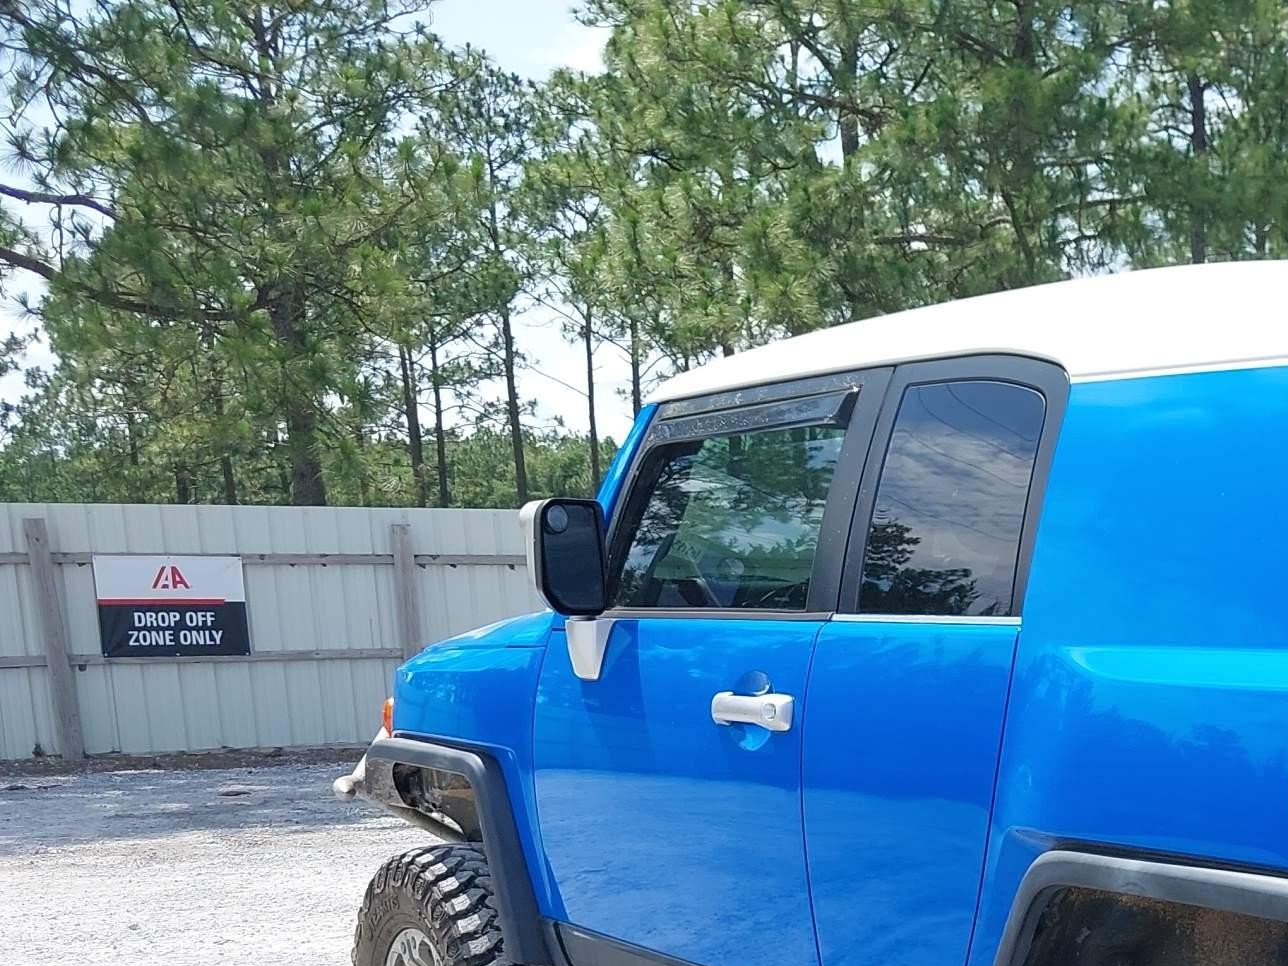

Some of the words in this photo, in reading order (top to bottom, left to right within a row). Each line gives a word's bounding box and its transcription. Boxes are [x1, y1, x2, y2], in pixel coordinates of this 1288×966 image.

[133, 612, 180, 628] DROP
[185, 612, 216, 627] OFF
[128, 630, 176, 646] ZONE
[180, 630, 224, 646] ONLY
